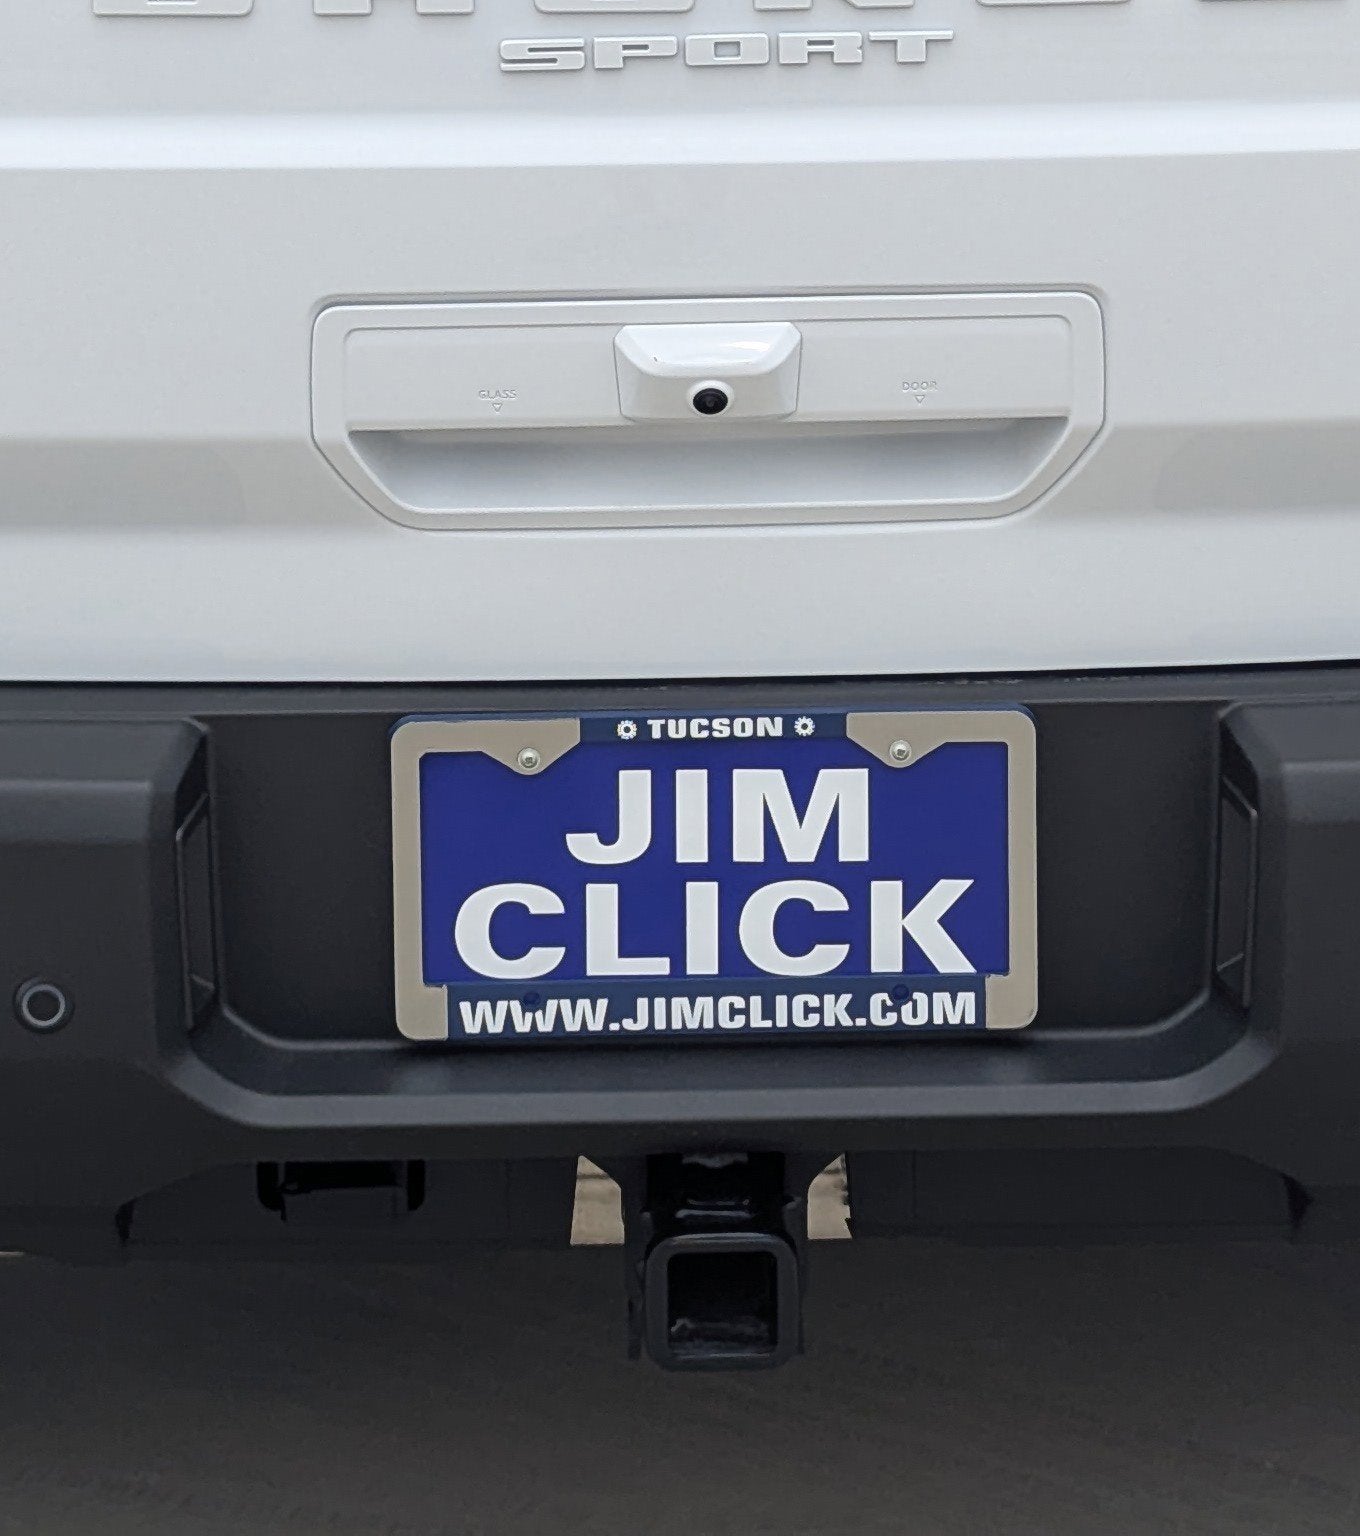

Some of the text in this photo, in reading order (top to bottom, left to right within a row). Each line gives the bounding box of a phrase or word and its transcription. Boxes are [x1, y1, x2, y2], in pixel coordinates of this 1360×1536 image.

[499, 31, 954, 71] SPORT
[478, 389, 517, 400] GLASS
[902, 380, 938, 391] DOOR
[647, 716, 783, 739] TUCSON
[565, 768, 870, 864] JIM
[454, 879, 977, 980] CLICK
[459, 992, 976, 1034] WWW.JIMCLICK.COM
